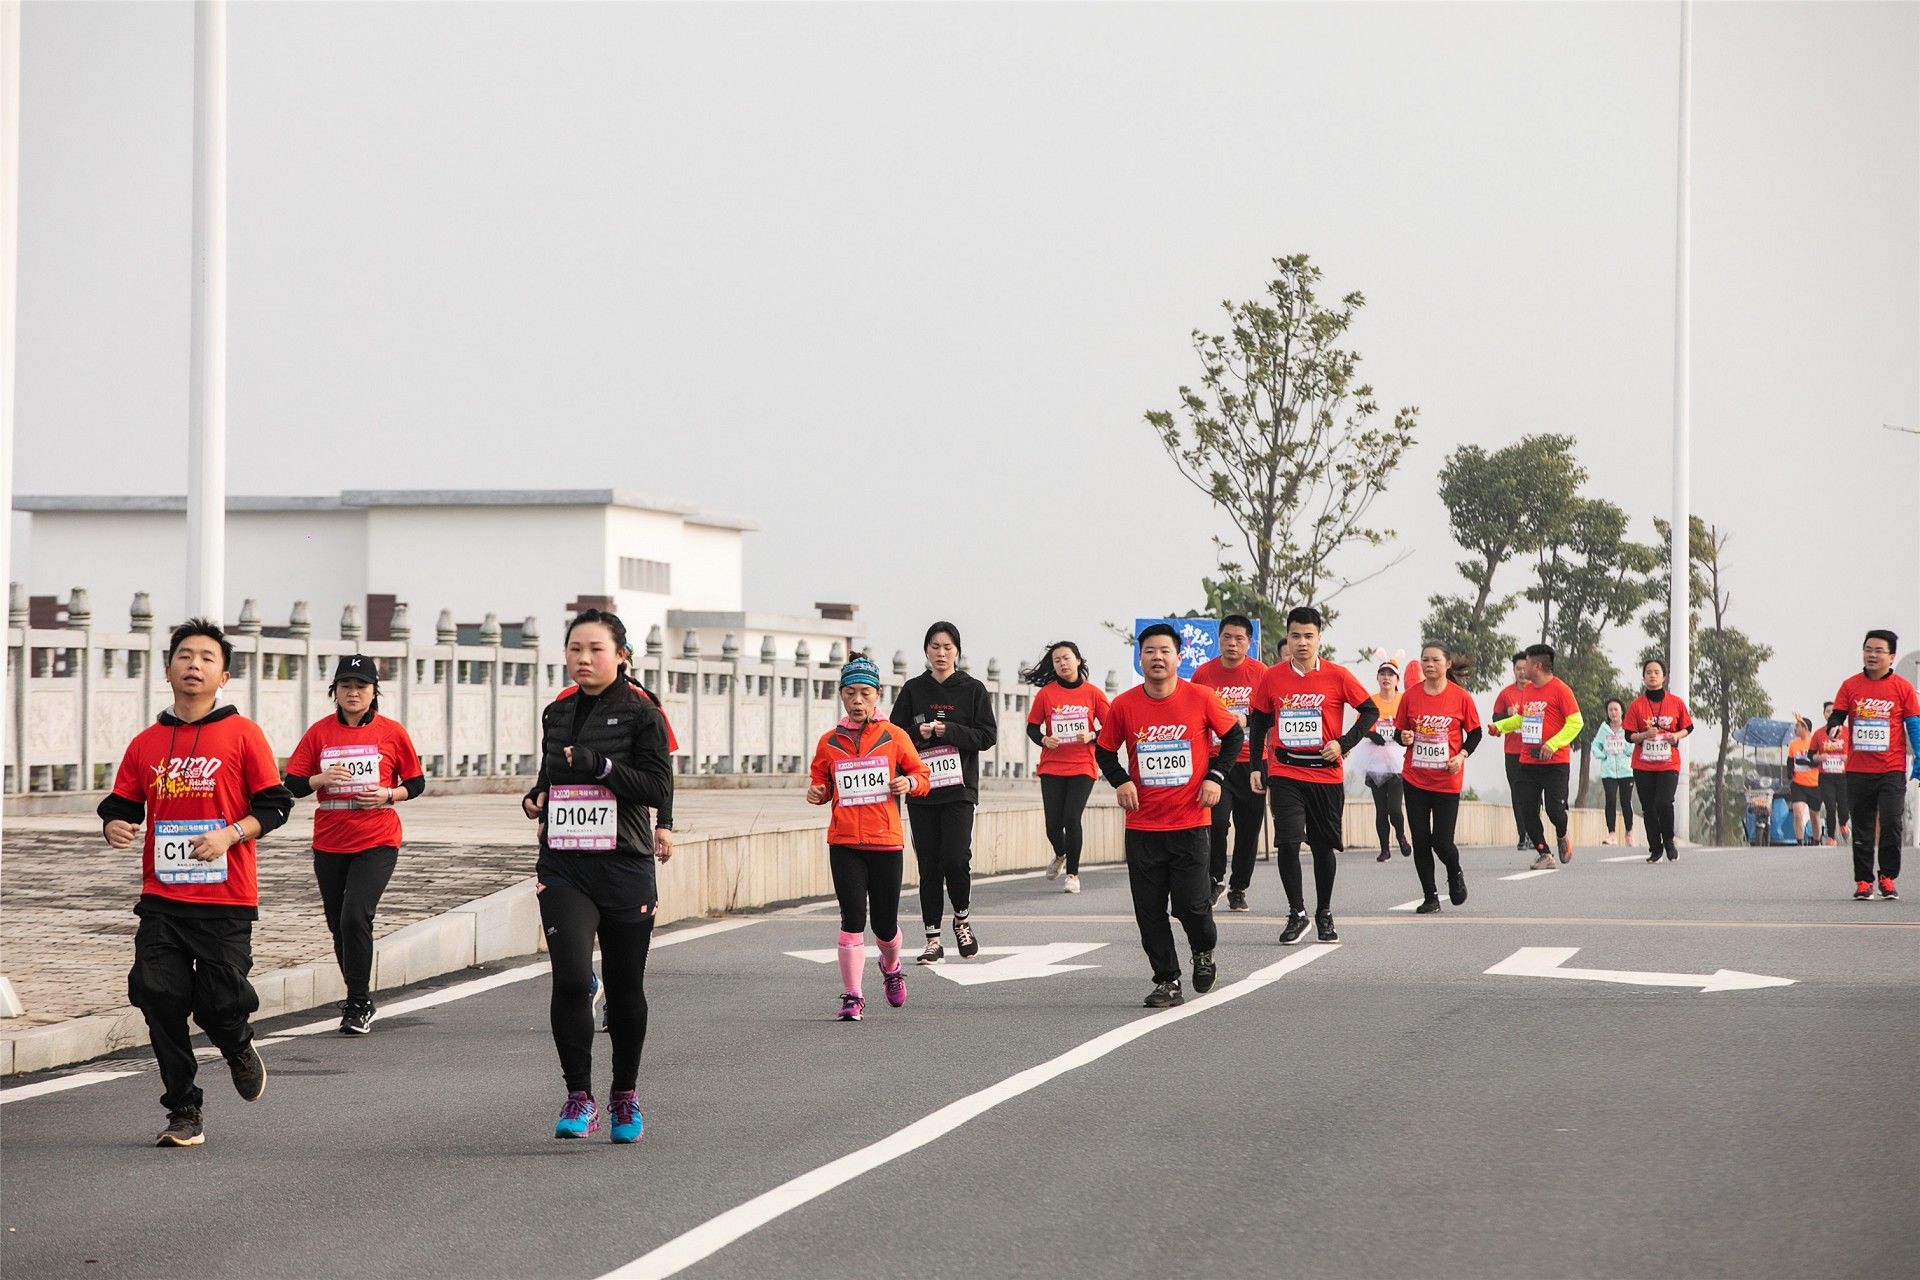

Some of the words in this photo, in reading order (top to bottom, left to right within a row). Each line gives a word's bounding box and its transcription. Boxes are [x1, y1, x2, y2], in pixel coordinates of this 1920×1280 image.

[351, 658, 361, 667] K
[1222, 686, 1253, 699] 2020
[1291, 694, 1326, 707] 2020
[1864, 698, 1895, 711] 2020
[1057, 721, 1085, 733] D1156
[1284, 721, 1318, 733] C1259
[1422, 715, 1453, 728] 2020
[1147, 725, 1188, 741] 2020
[1857, 729, 1886, 740] C1693
[1416, 744, 1445, 757] D1064
[925, 758, 957, 774] 1103
[1146, 755, 1186, 770] C1260
[843, 772, 885, 789] D1184
[556, 807, 608, 826] D1047
